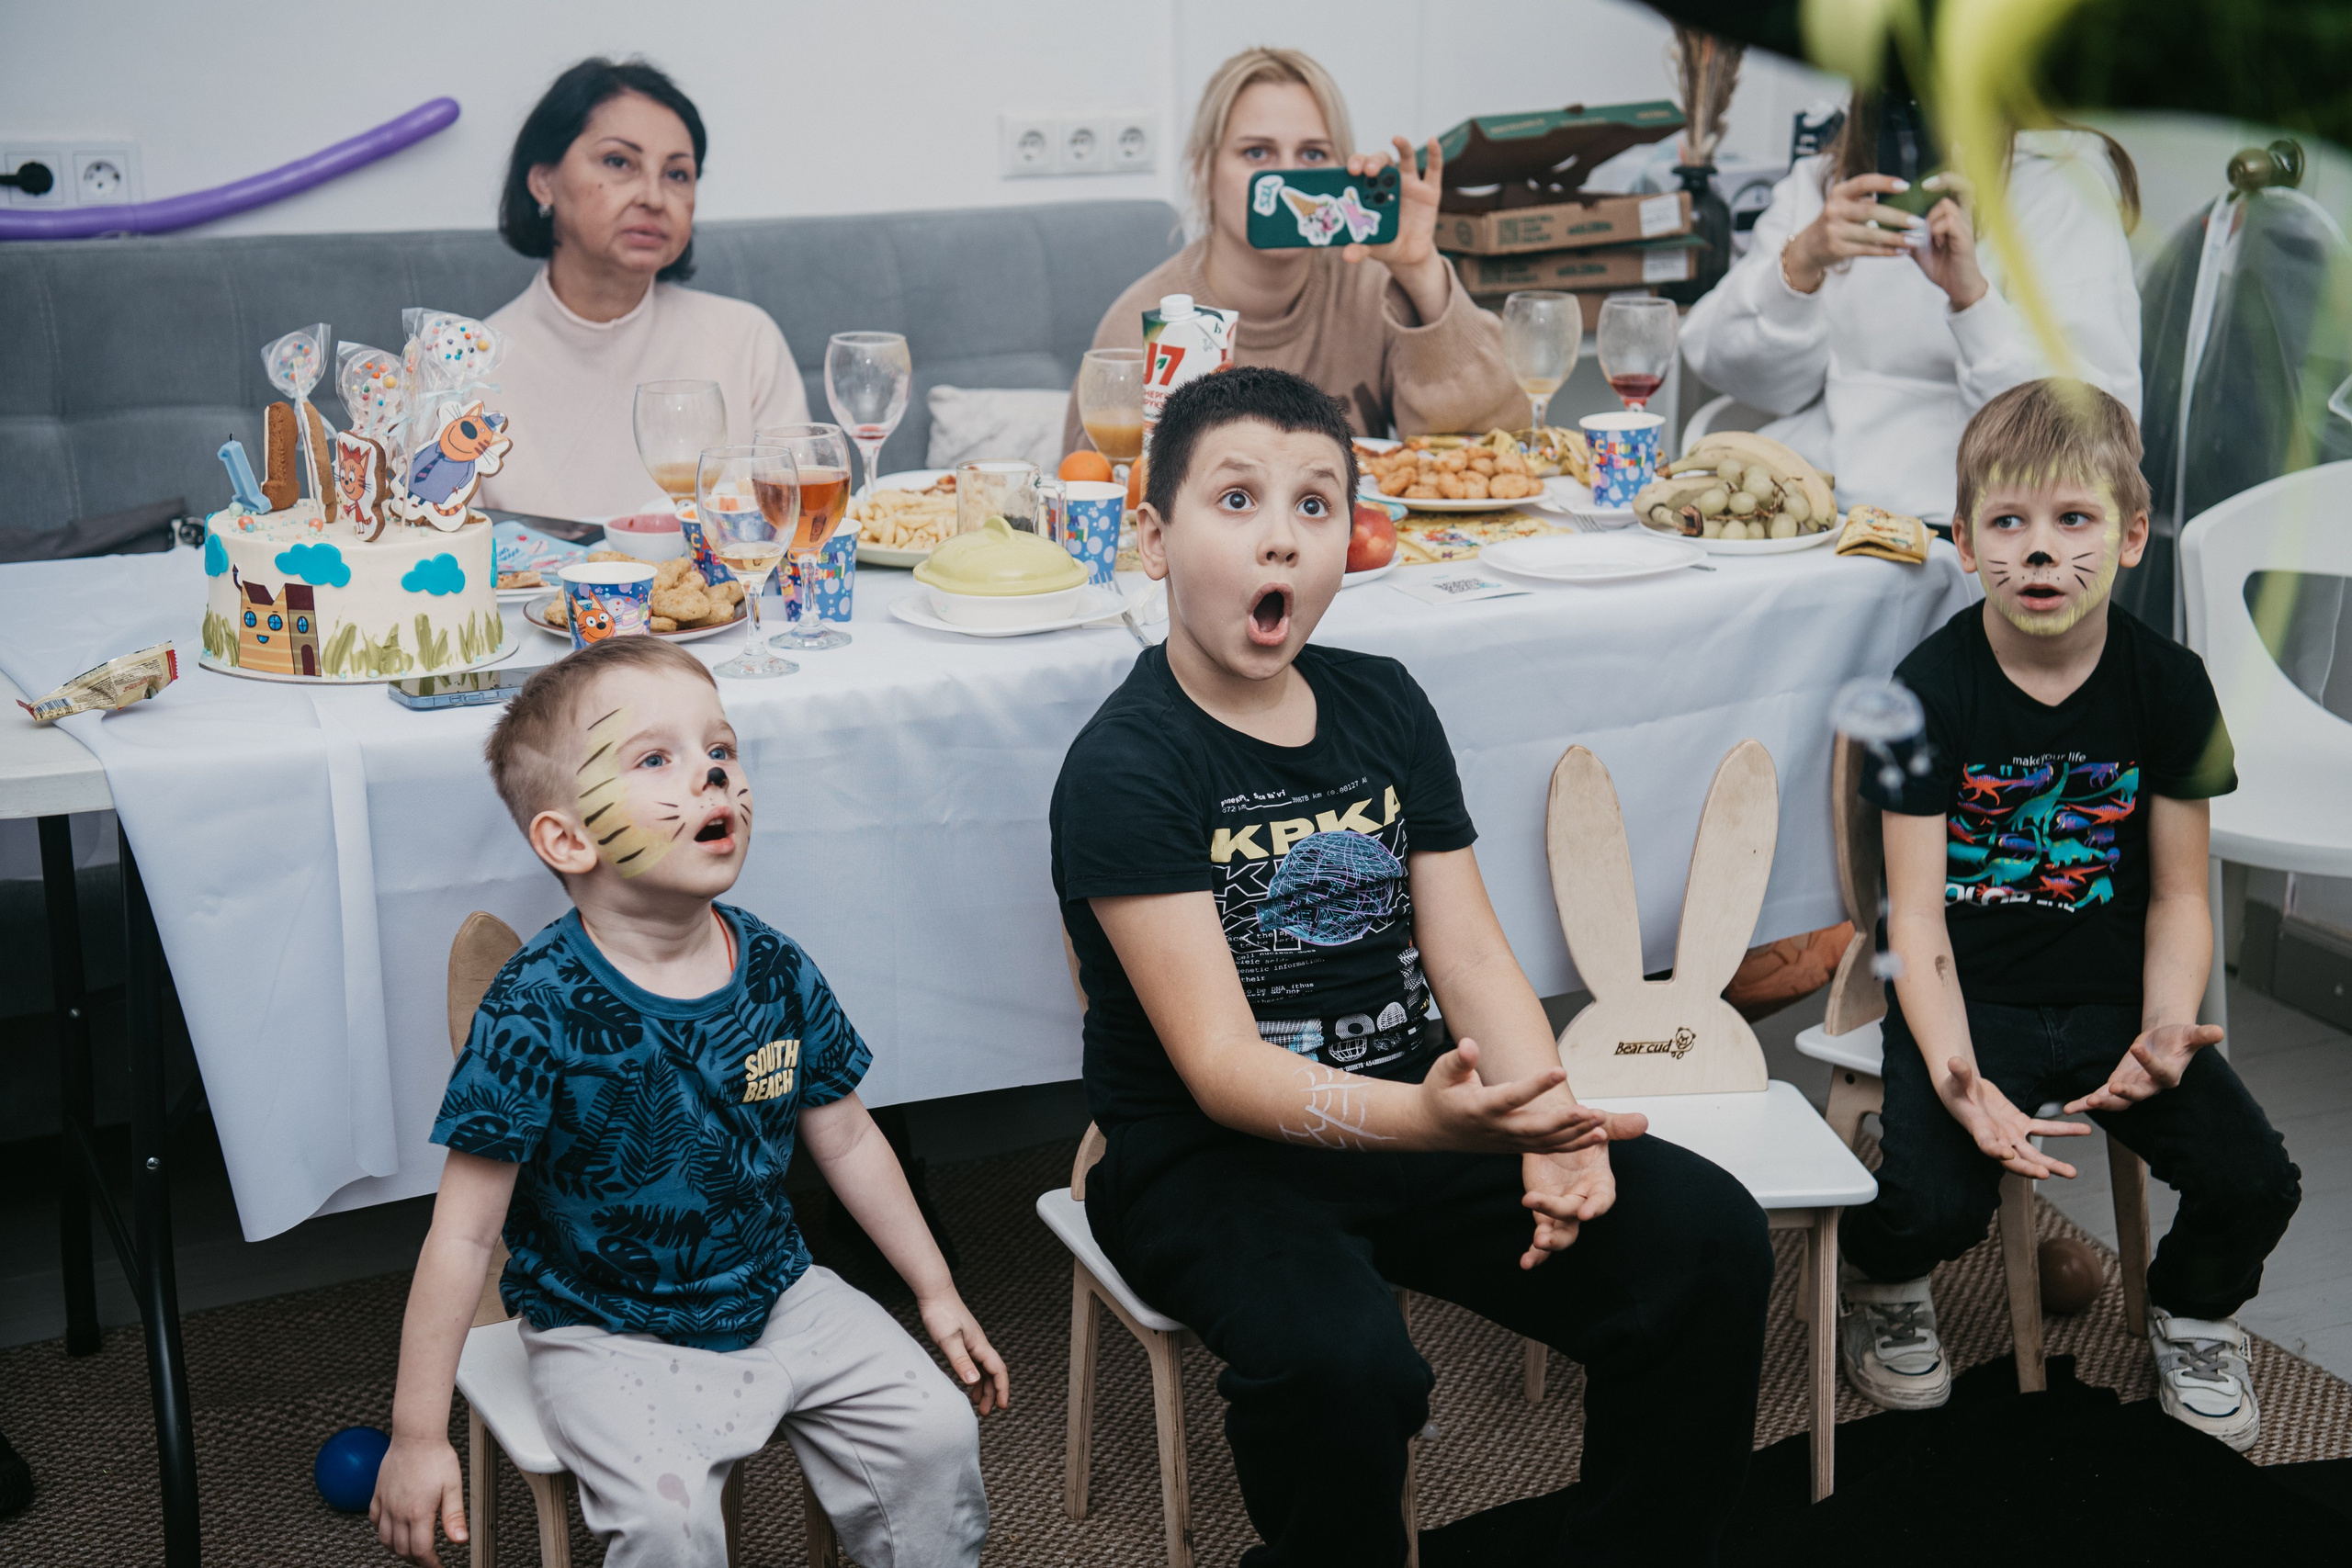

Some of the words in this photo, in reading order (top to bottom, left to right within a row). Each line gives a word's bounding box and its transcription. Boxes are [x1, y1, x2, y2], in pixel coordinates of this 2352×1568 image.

[2068, 750, 2086, 762] life
[1614, 1041, 1644, 1055] Bear
[744, 1039, 800, 1082] SOUTH
[741, 1068, 794, 1103] BEACH
